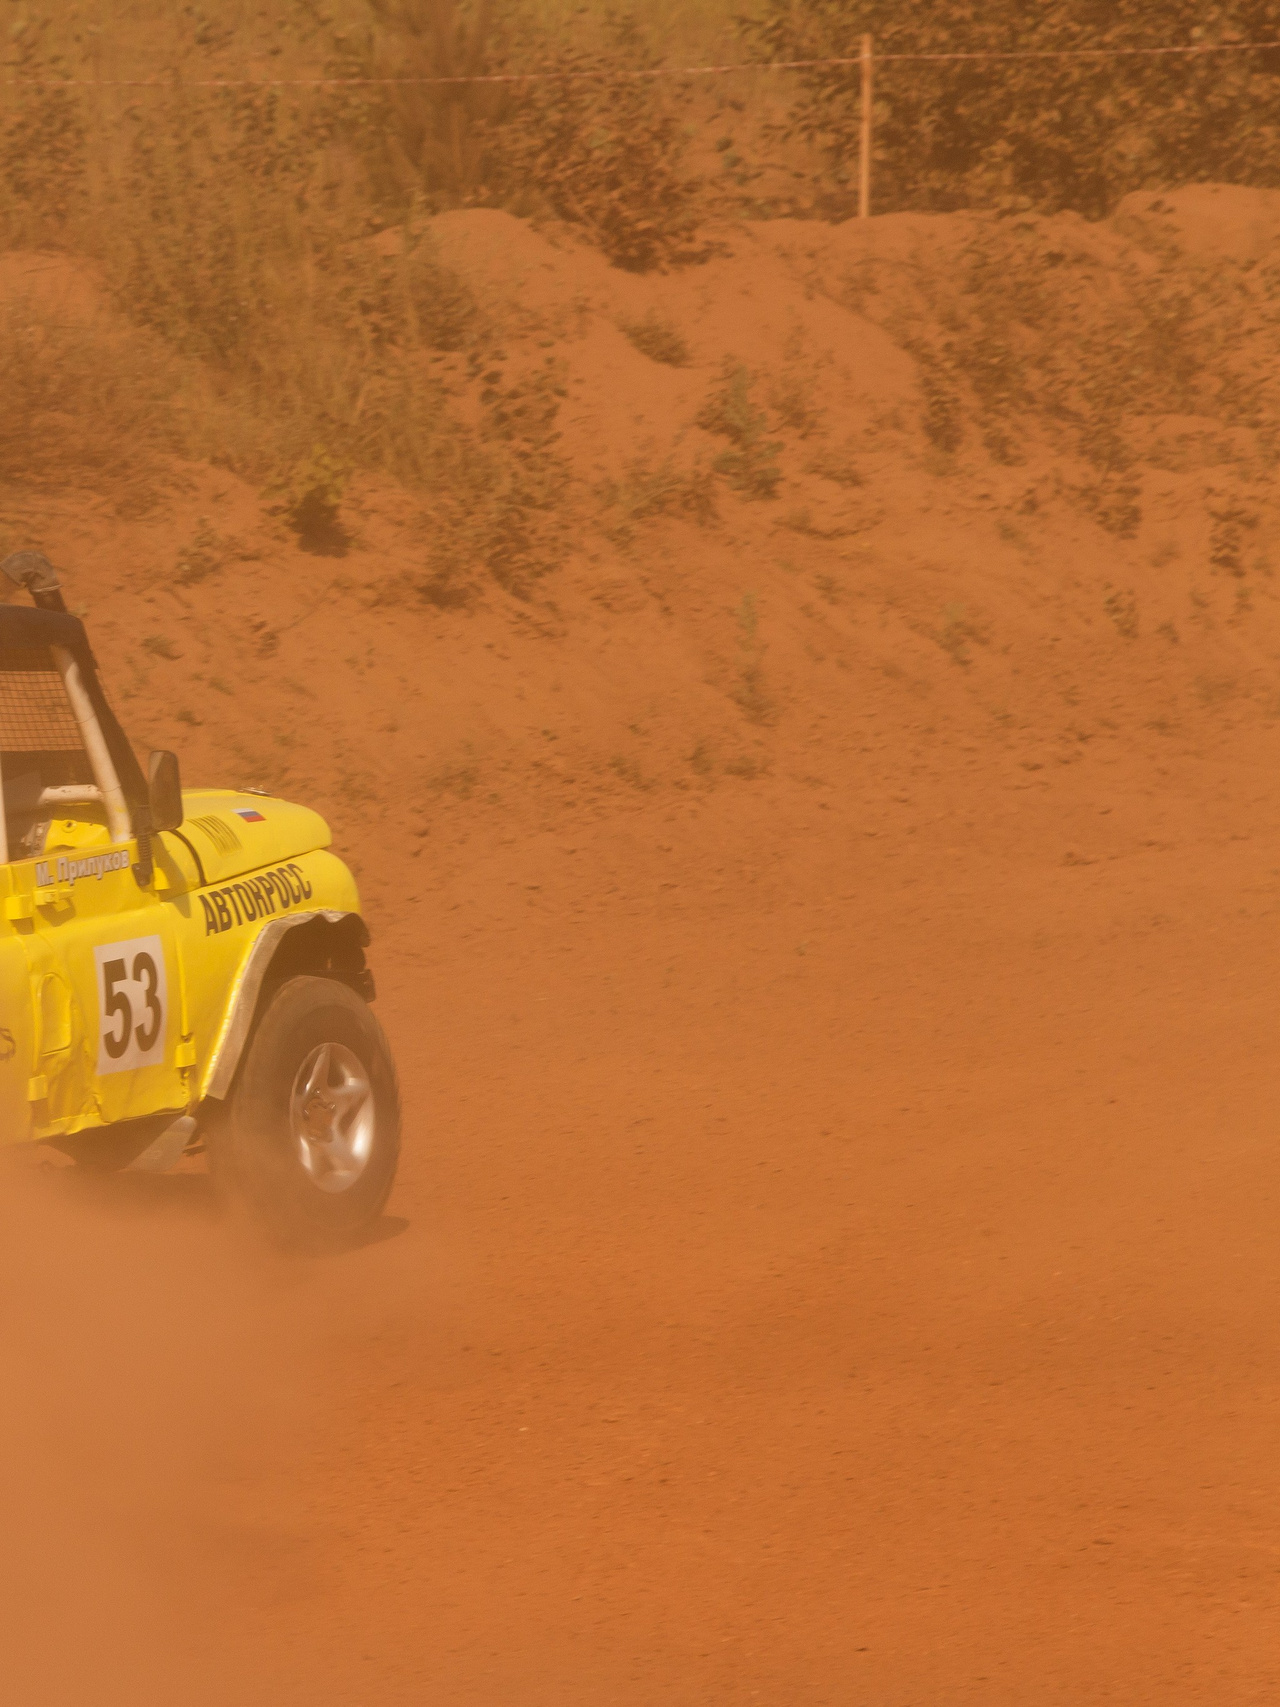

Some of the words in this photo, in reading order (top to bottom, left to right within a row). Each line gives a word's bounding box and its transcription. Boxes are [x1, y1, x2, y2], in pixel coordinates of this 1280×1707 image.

[36, 861, 54, 887] М.
[197, 863, 312, 936] АВТОКРОСС
[103, 951, 162, 1058] 53
